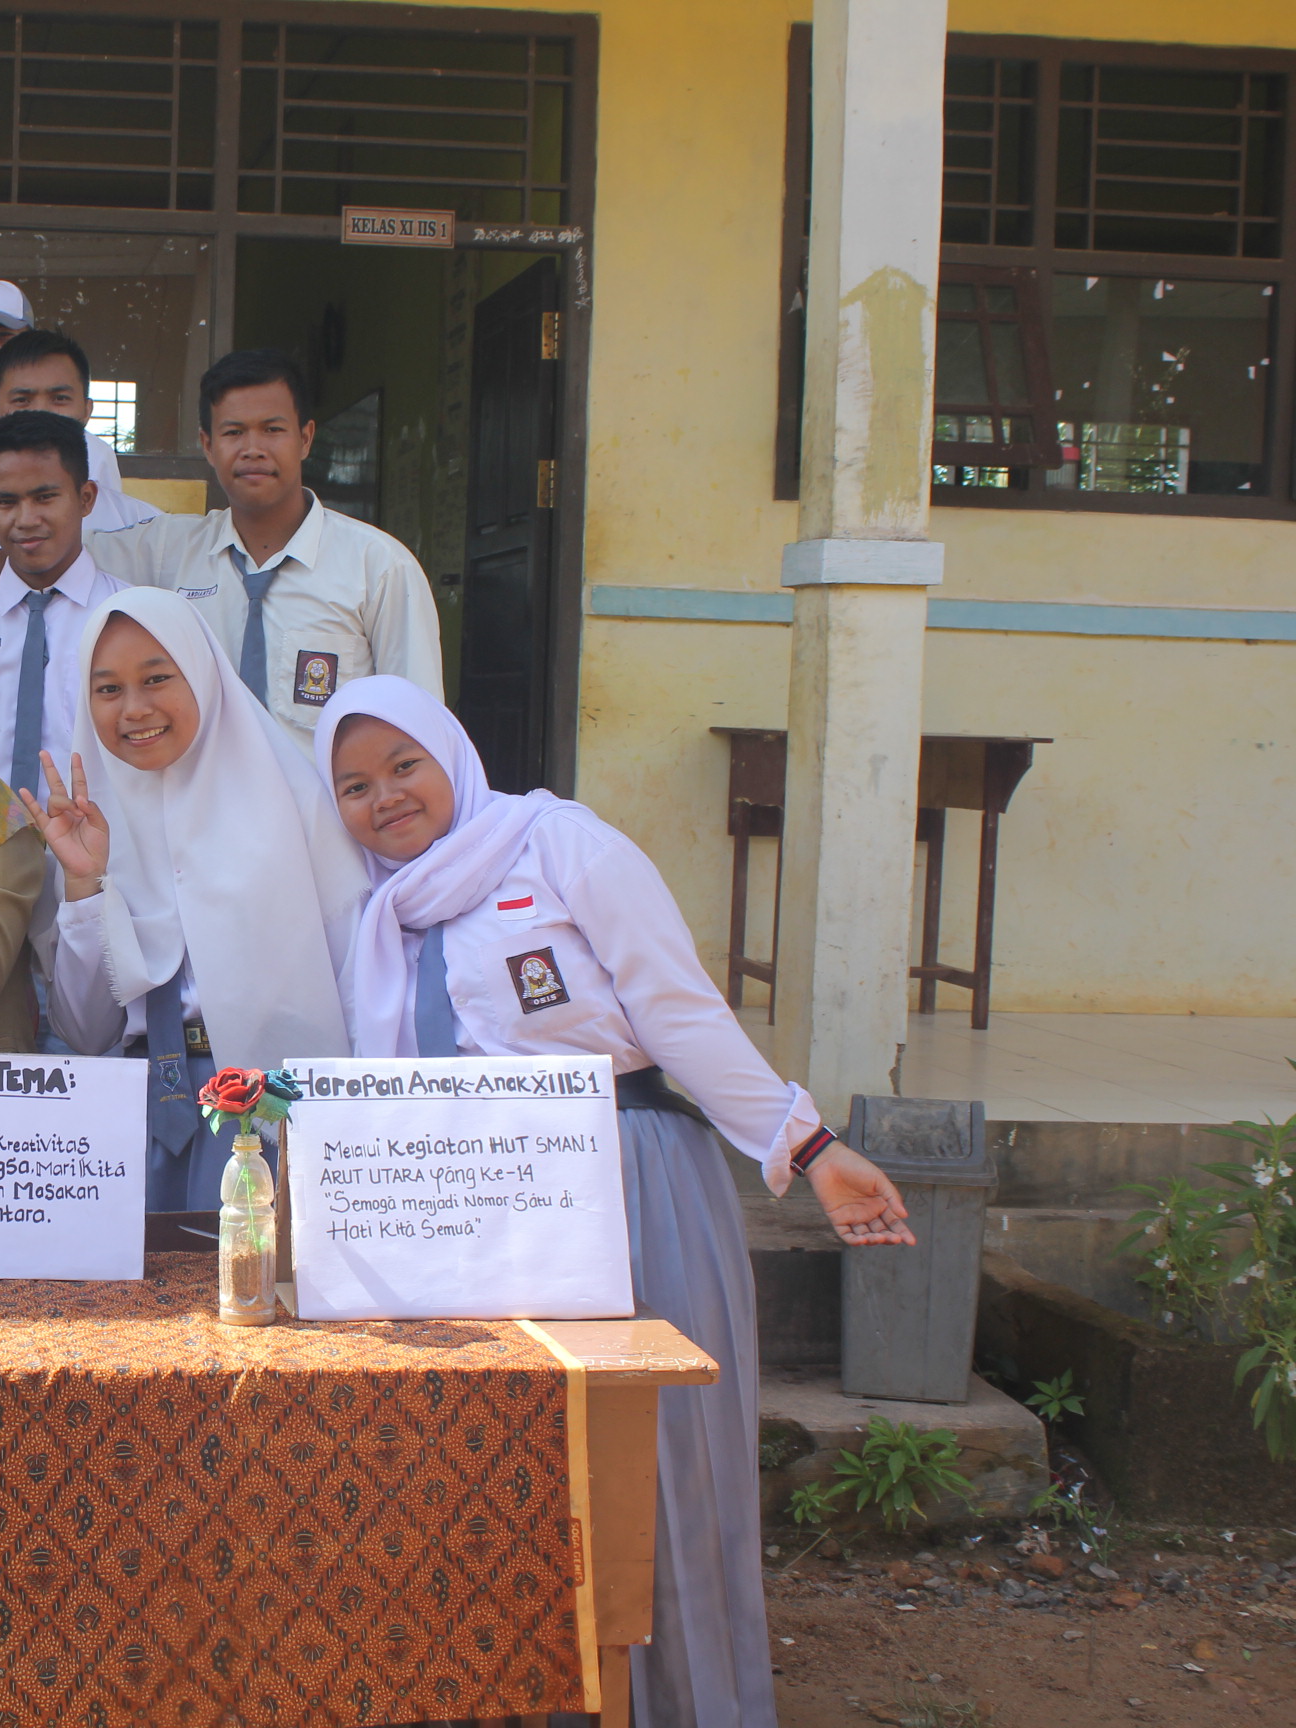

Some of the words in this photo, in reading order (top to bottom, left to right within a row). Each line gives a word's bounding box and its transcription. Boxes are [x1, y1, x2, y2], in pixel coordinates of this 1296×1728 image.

[351, 217, 395, 235] KELAS
[399, 219, 414, 236] XI
[417, 220, 436, 237] IIS
[441, 223, 446, 237] 1
[304, 693, 325, 701] OSIS
[533, 994, 557, 1005] OSIS
[588, 1071, 600, 1093] 1
[388, 1134, 483, 1159] Kegiatan
[489, 1136, 529, 1154] HUT
[536, 1135, 585, 1153] SMAN
[590, 1136, 598, 1152] 1
[36, 1159, 76, 1177] Mari
[320, 1168, 363, 1186] ARUT
[369, 1168, 425, 1184] UTARA
[14, 1182, 99, 1200] Masakan
[402, 1194, 459, 1216] menjadi
[464, 1195, 509, 1207] Nomor
[513, 1192, 552, 1211] Satu
[560, 1190, 573, 1208] di
[327, 1219, 372, 1241] Hati
